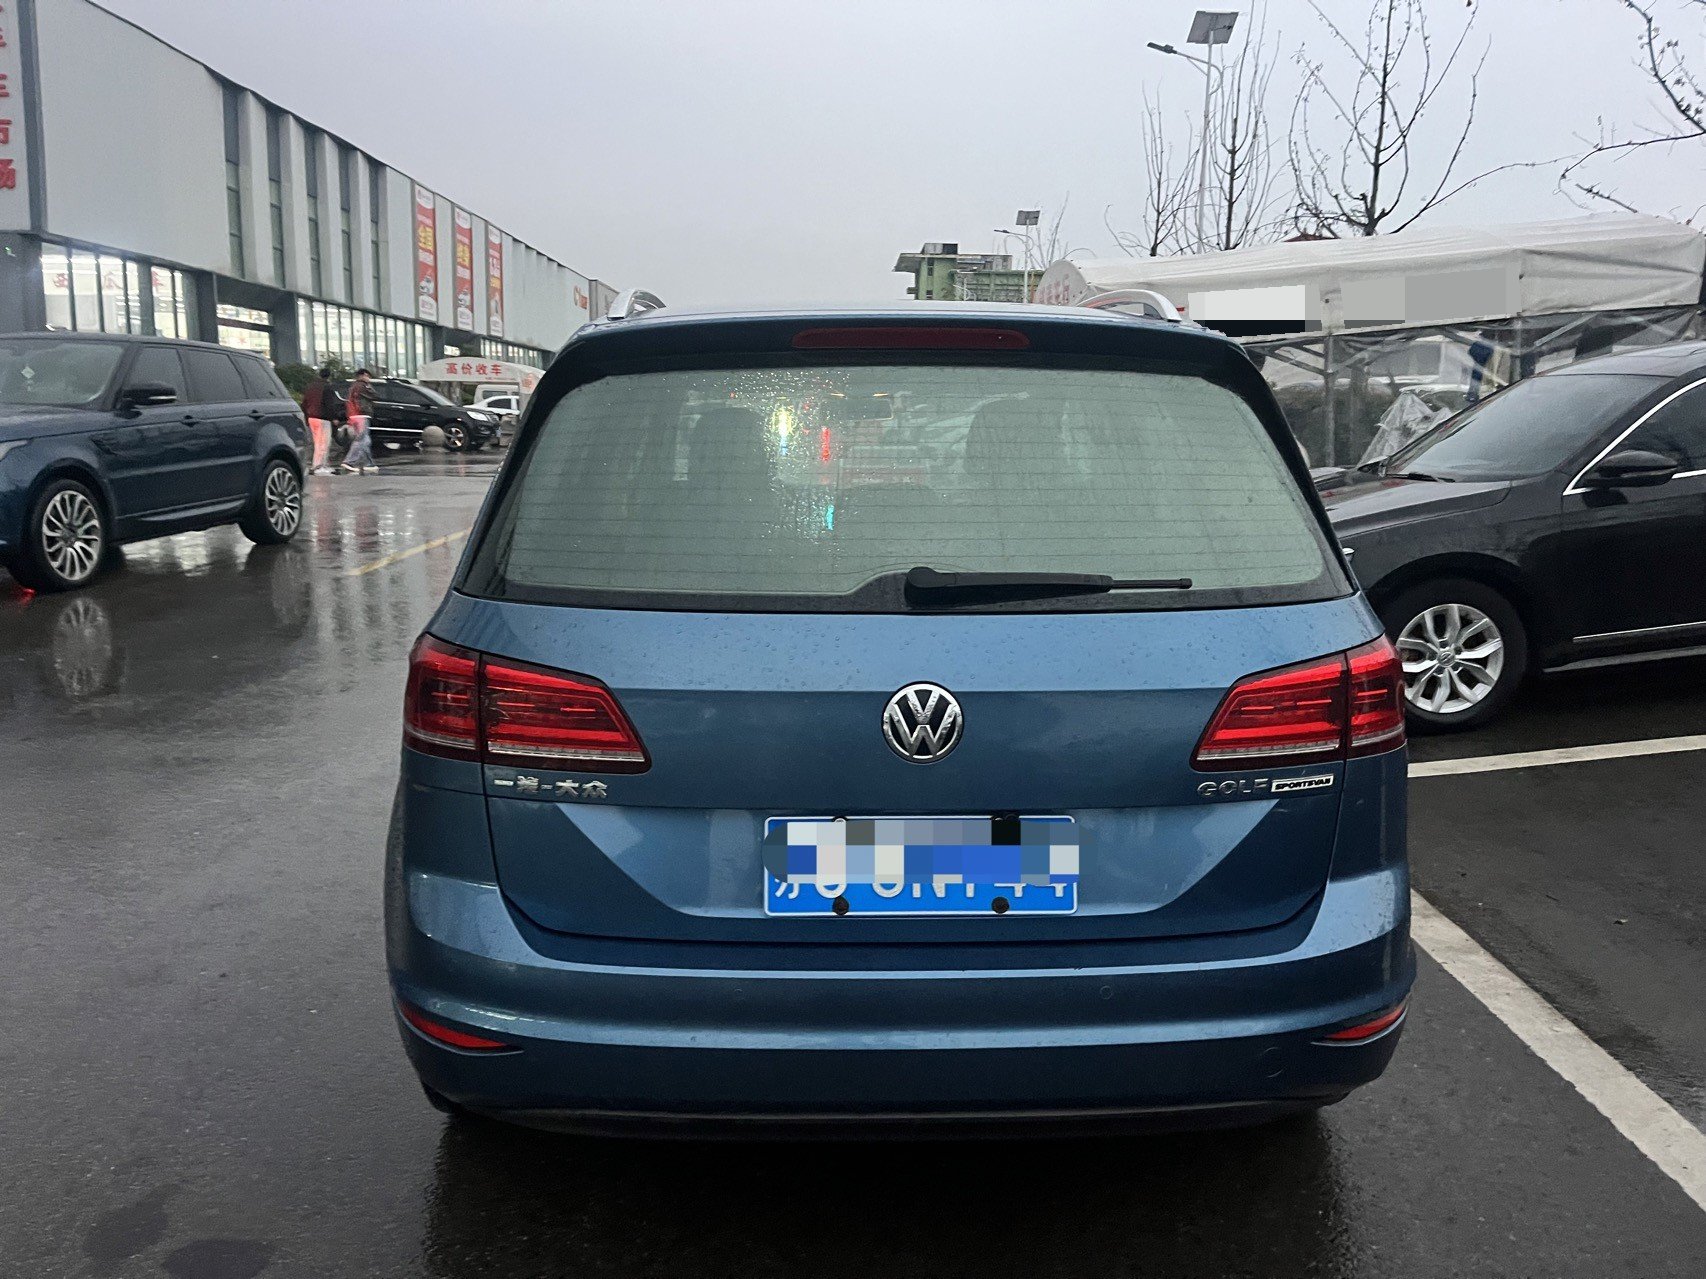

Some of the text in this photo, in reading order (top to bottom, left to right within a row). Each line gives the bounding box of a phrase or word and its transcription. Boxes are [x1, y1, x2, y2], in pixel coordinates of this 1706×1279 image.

[446, 362, 502, 376] 高价收车
[884, 683, 963, 761] VW
[1197, 777, 1331, 796] GOLF SPORTSVAN
